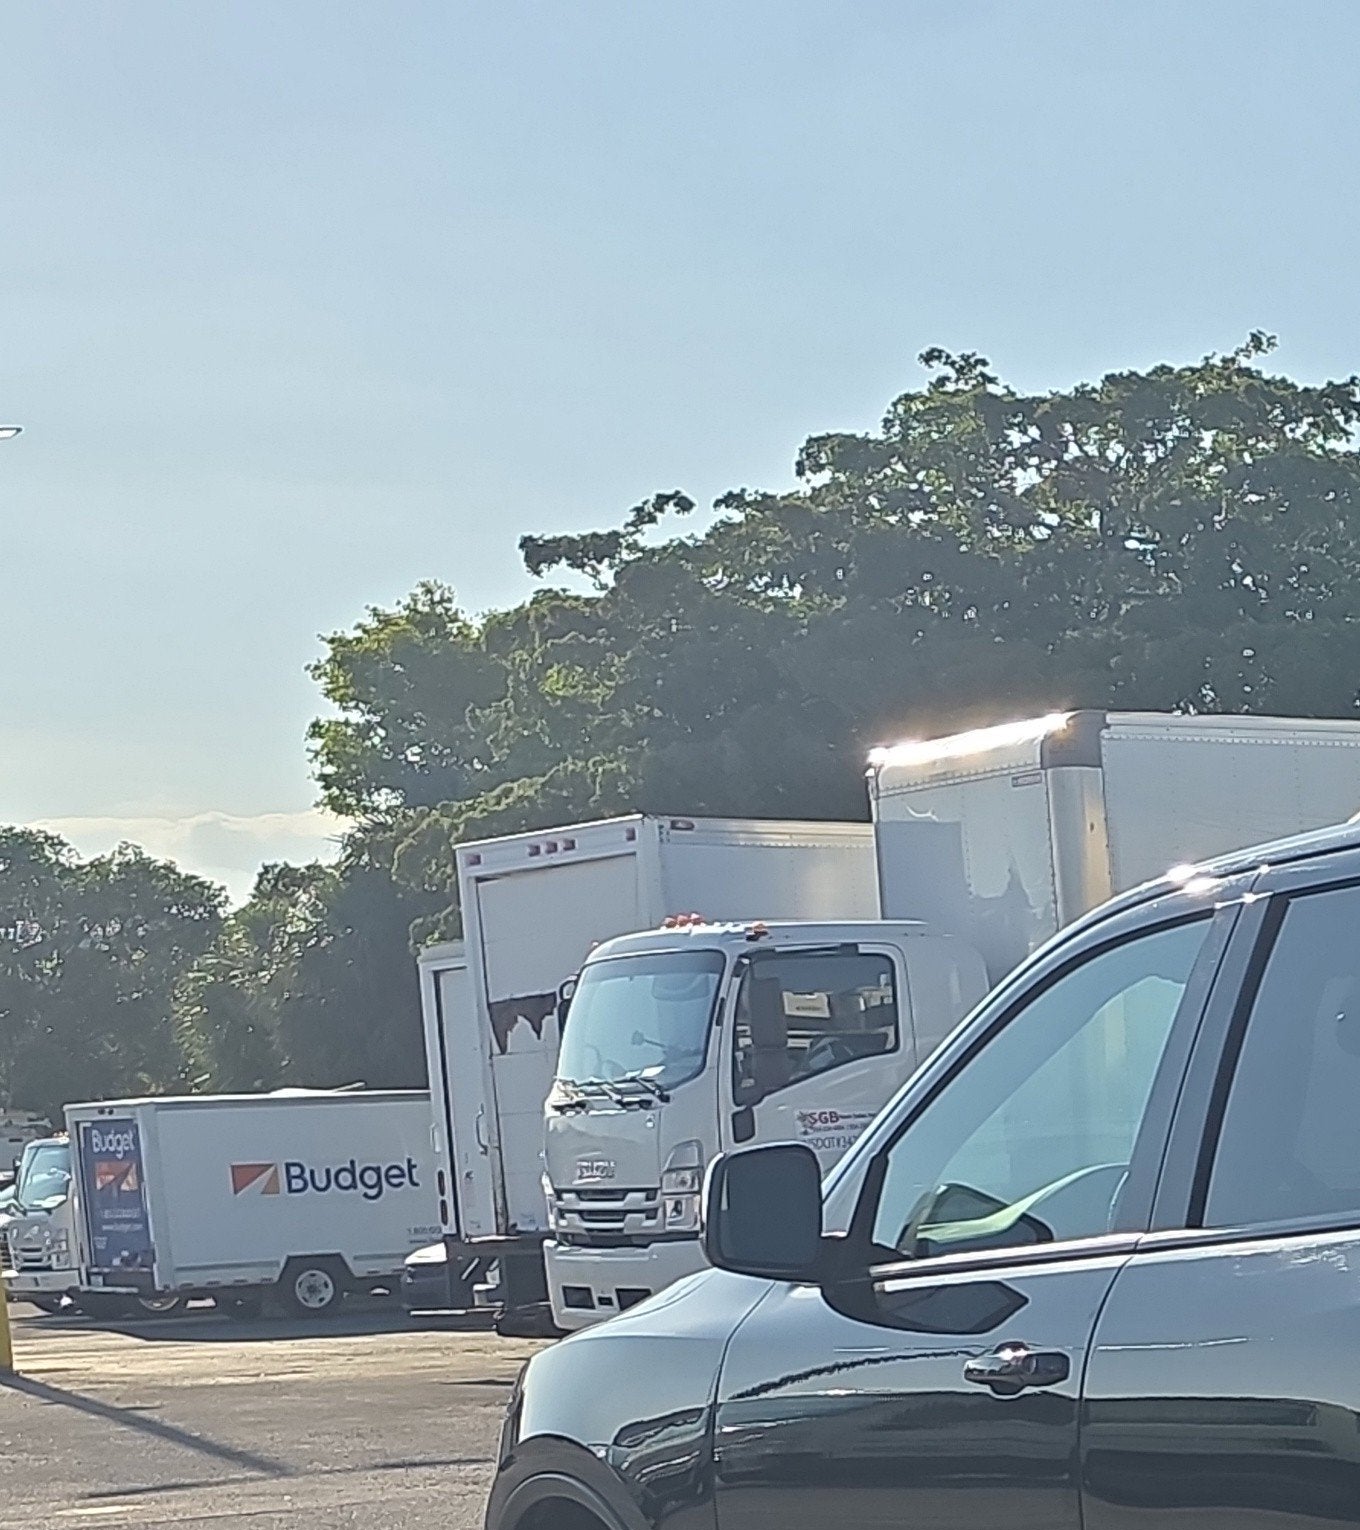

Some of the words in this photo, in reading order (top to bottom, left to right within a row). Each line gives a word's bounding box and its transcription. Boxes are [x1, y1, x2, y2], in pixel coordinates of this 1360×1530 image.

[808, 1110, 840, 1125] SGB
[91, 1129, 135, 1160] Budget
[284, 1157, 420, 1200] Budget
